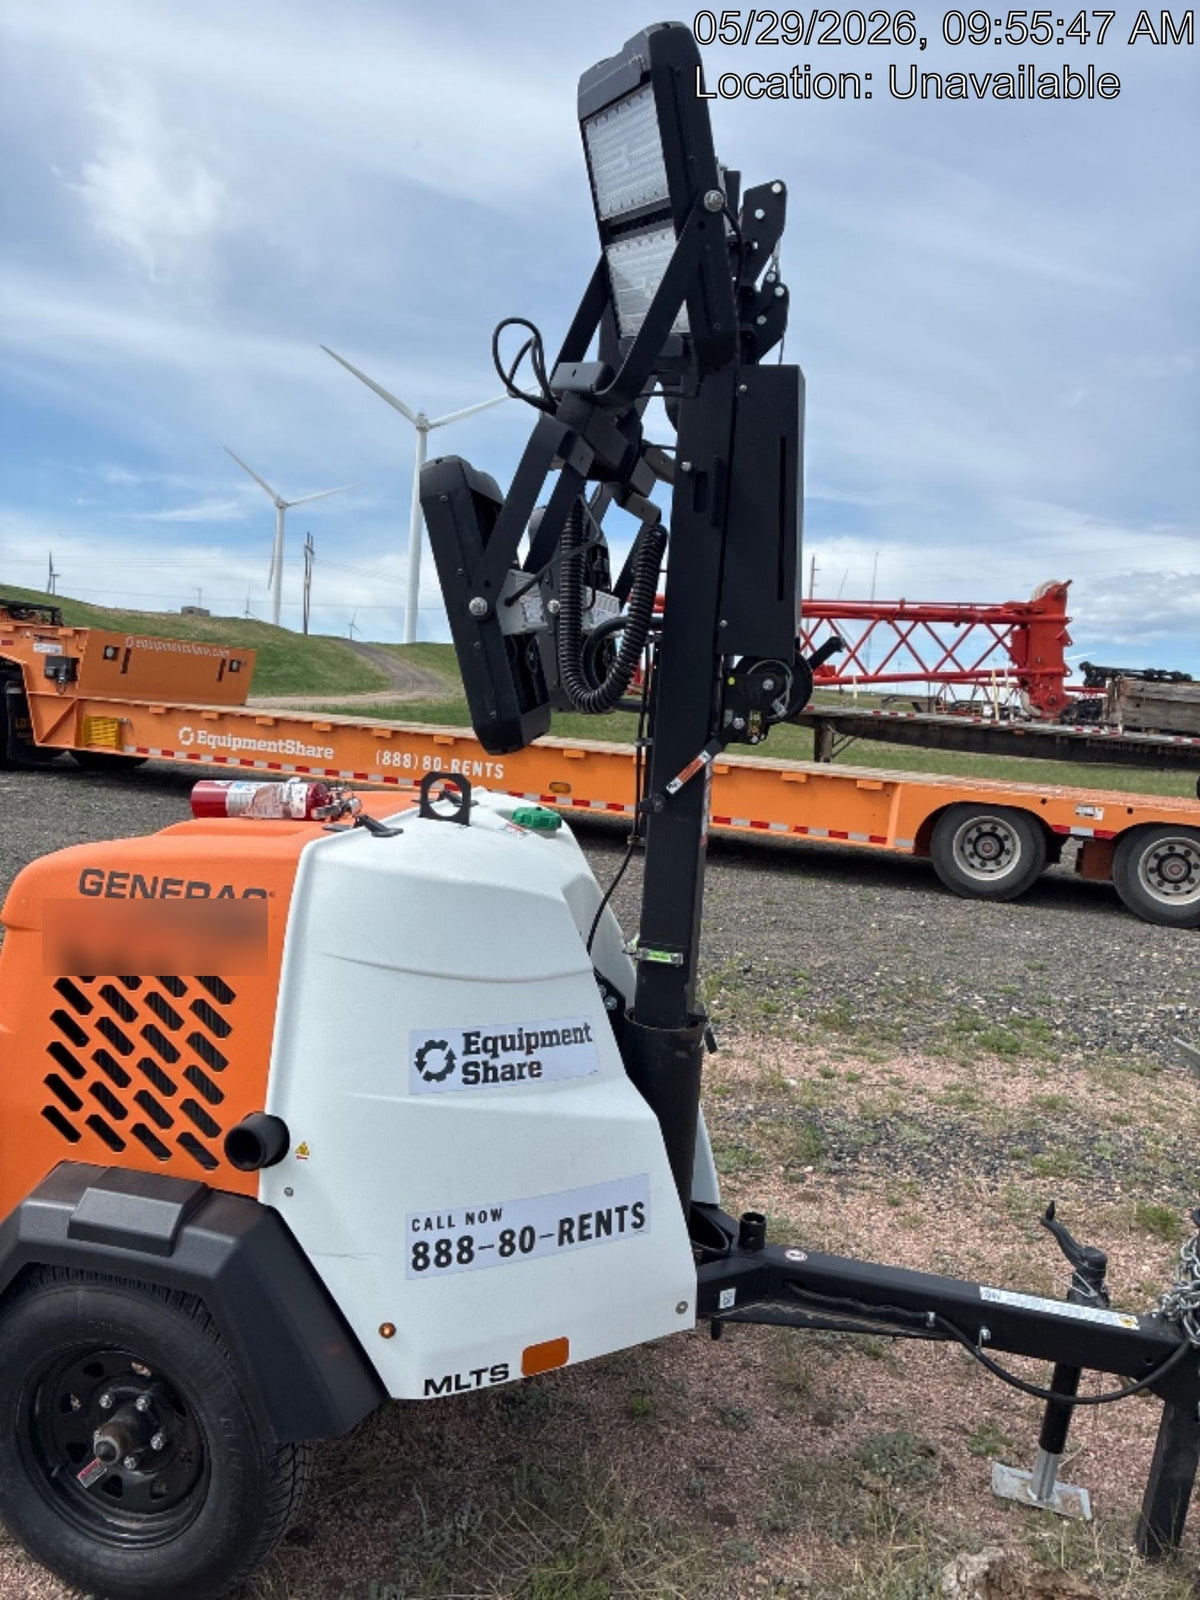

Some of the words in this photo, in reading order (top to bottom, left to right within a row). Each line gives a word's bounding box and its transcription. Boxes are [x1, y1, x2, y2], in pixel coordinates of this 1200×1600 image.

[197, 730, 334, 760] EquipmentShare
[462, 1022, 592, 1059] Equipment
[462, 1060, 543, 1085] Share
[411, 1216, 456, 1232] CALL
[465, 1208, 503, 1226] NOW
[411, 1201, 646, 1272] 888-80-RENTS
[424, 1363, 509, 1396] MLTS
